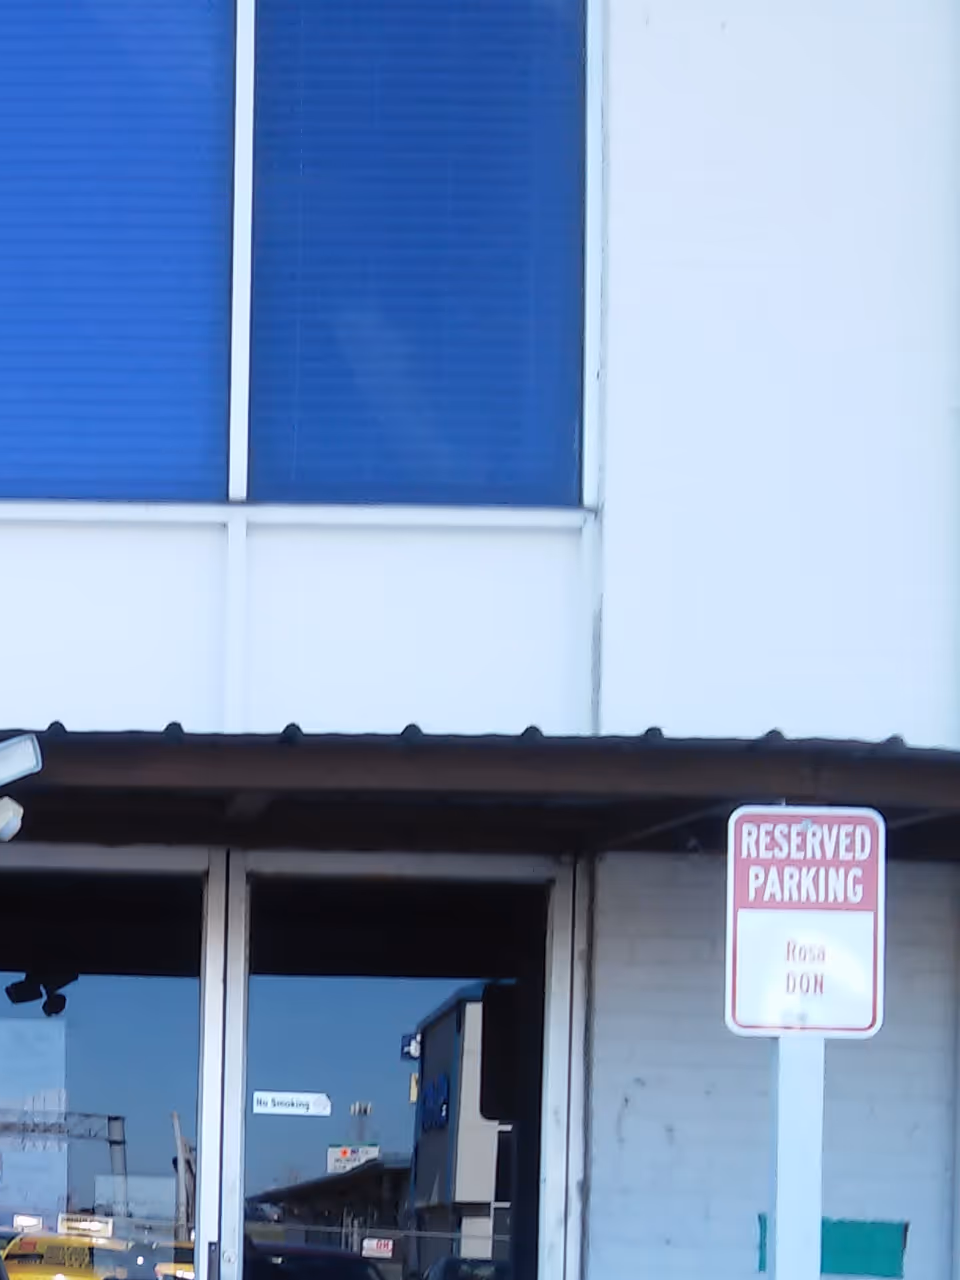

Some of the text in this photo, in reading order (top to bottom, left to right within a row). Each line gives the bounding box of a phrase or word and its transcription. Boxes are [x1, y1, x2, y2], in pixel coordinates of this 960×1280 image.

[741, 823, 871, 862] RESERVED
[748, 865, 864, 904] PARKING
[786, 940, 826, 963] Rosa
[786, 971, 824, 995] DON
[256, 1097, 310, 1113] No Smoking
